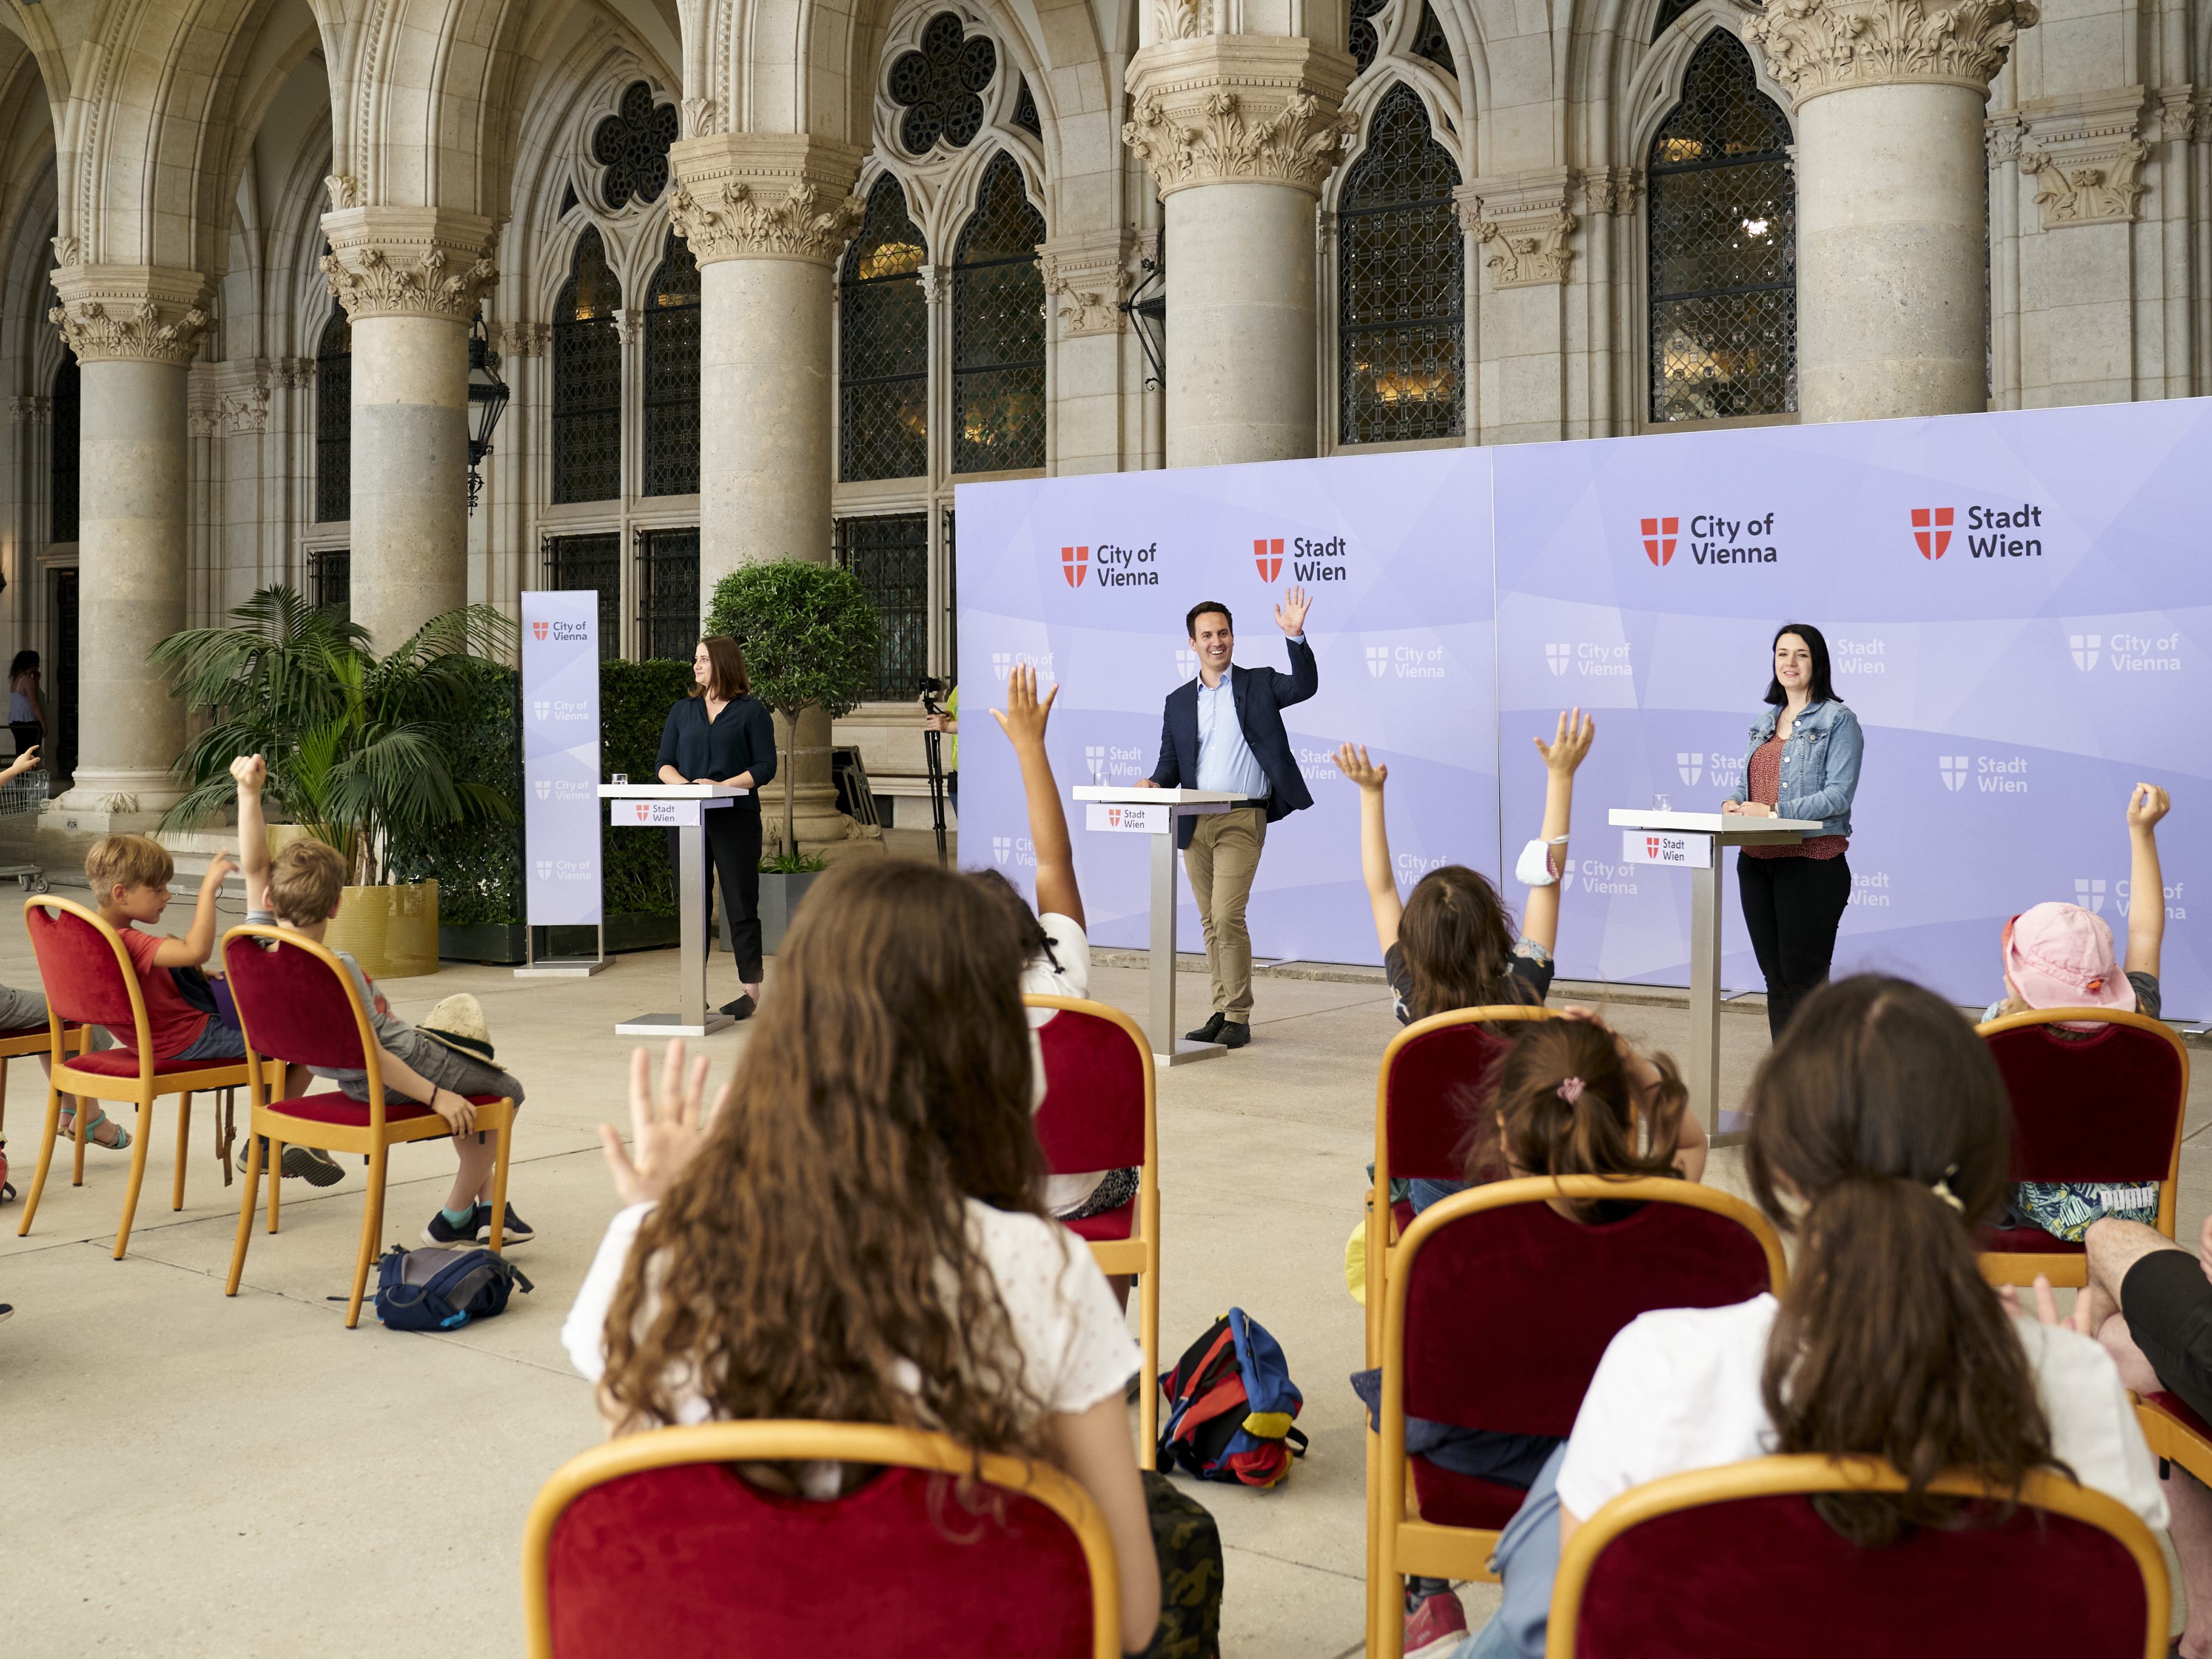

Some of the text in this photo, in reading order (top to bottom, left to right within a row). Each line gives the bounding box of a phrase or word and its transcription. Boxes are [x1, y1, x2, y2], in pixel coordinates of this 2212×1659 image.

[1968, 504, 2042, 530] Stadt
[1691, 513, 1774, 543] City of
[1294, 536, 1346, 558] Stadt
[1691, 542, 1777, 564] Vienna
[1968, 534, 2042, 558] Wien
[1097, 543, 1157, 569] City of
[1097, 568, 1159, 586] Vienna
[1294, 561, 1346, 581] Wien
[553, 621, 586, 632] City of
[1838, 638, 1885, 655] Stadt
[2111, 633, 2179, 655] City of
[1041, 652, 1054, 665] of
[1394, 646, 1443, 665] City of
[1578, 643, 1631, 662] City of
[1394, 663, 1444, 678] Vienna
[1578, 661, 1632, 676] Vienna
[1838, 658, 1885, 674] Wien
[2111, 654, 2180, 671] Vienna
[554, 700, 587, 713] City of
[554, 711, 589, 720] Vienna
[1110, 746, 1142, 760] Stadt
[1301, 748, 1335, 763] Stad
[1711, 753, 1747, 768] Stad
[1110, 762, 1142, 776] Wien
[1300, 765, 1336, 779] Wien
[1977, 756, 2028, 773] Stadt
[555, 780, 589, 792] City of
[1977, 776, 2028, 792] Wien
[555, 791, 590, 800] Vienna
[653, 804, 675, 813] Stadt
[1124, 809, 1145, 818] Stadt
[653, 813, 675, 822] Wien
[1124, 819, 1145, 828] Wien
[1016, 838, 1035, 855] Cit
[1663, 838, 1685, 849] Stadt
[1399, 853, 1447, 872] City of
[1663, 850, 1685, 861] Wien
[556, 860, 590, 872] City of
[1583, 860, 1635, 880] City of
[556, 871, 591, 880] Vienna
[1852, 872, 1889, 888] tadt
[1583, 878, 1637, 894] Vienna
[2163, 882, 2183, 900] of
